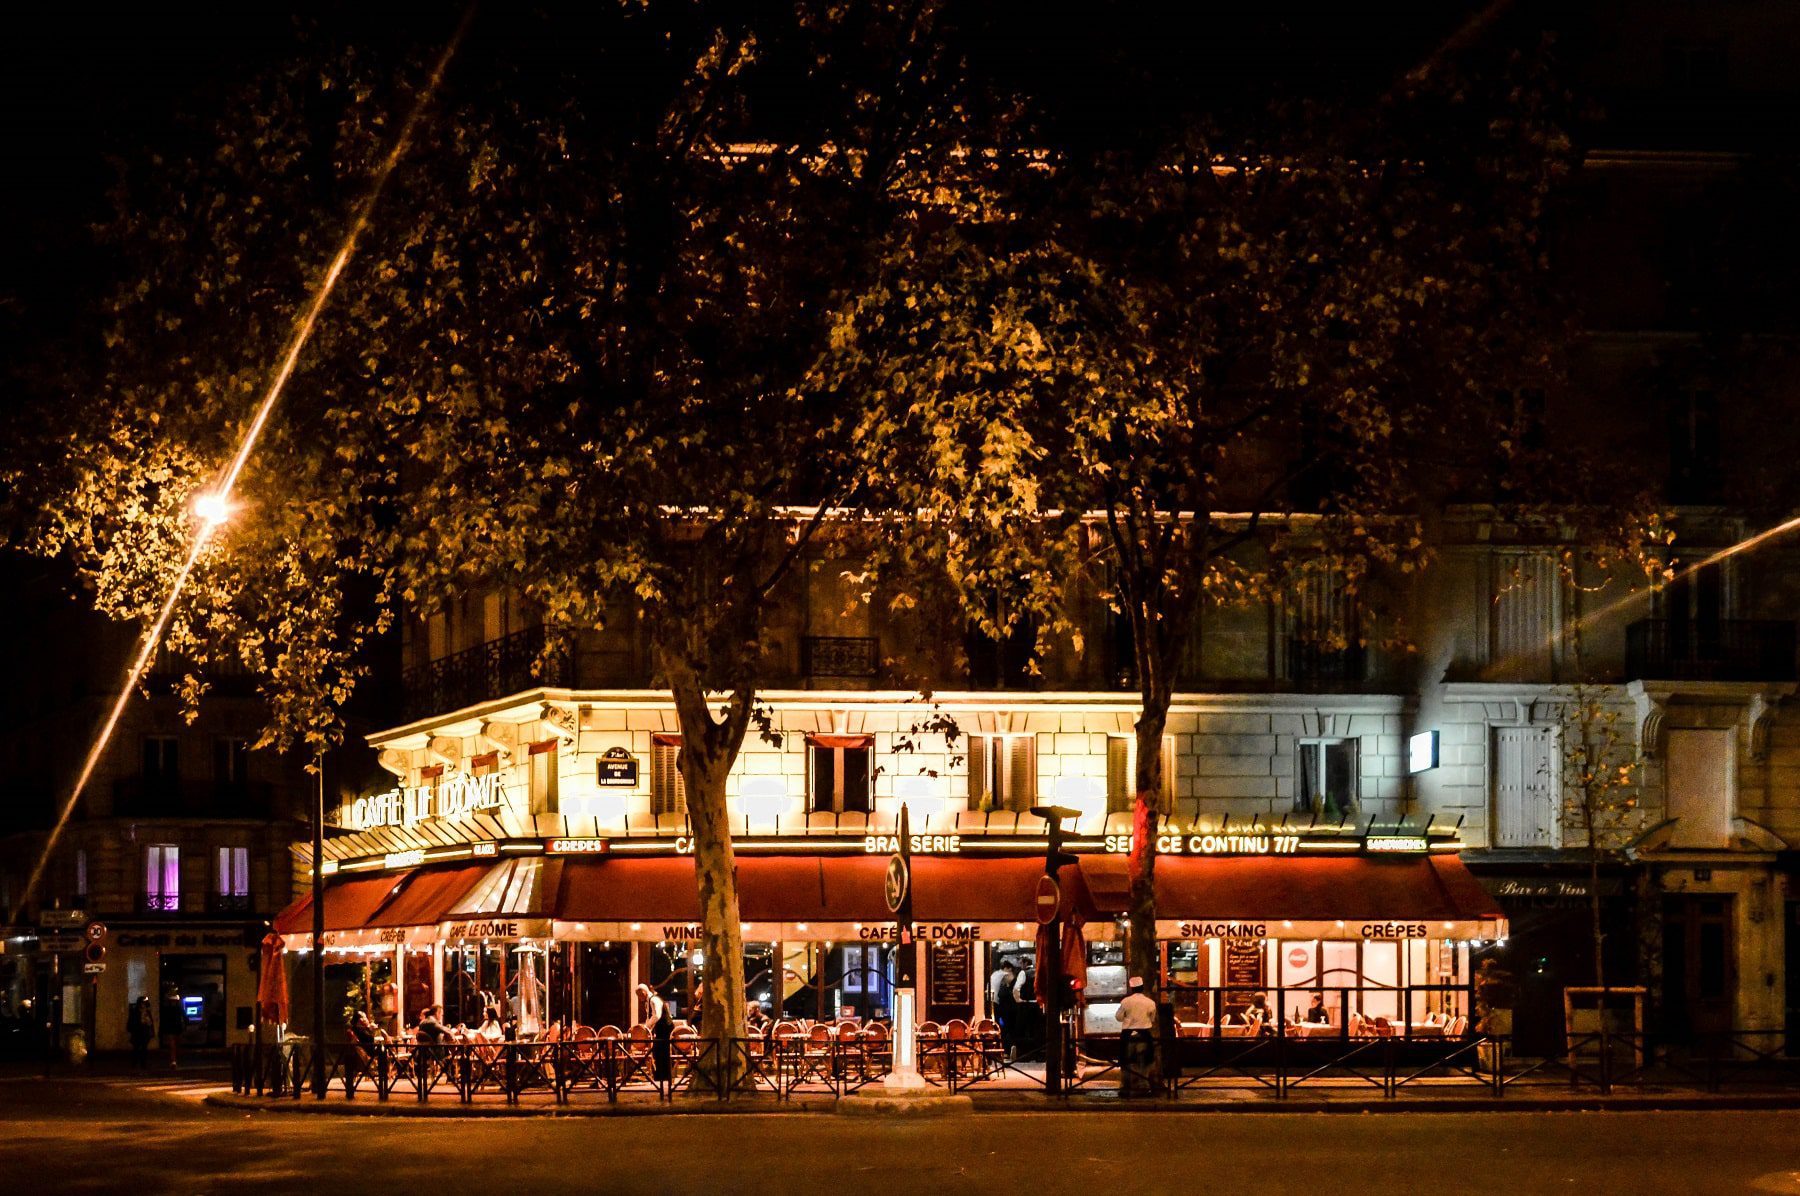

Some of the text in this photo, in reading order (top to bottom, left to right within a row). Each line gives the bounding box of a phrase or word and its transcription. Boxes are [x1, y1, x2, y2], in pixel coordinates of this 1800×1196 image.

[438, 772, 504, 815] DÔME
[865, 836, 960, 852] BRASERIE
[1105, 836, 1300, 853] SECE CONTINU 7/7
[1558, 881, 1587, 895] Vins
[468, 923, 479, 937] LE
[480, 921, 518, 937] DÔME
[860, 925, 898, 939] CAFÉ
[932, 923, 980, 939] DÔME
[1180, 924, 1267, 938] SNACKING
[1361, 921, 1427, 938] CRÊPES
